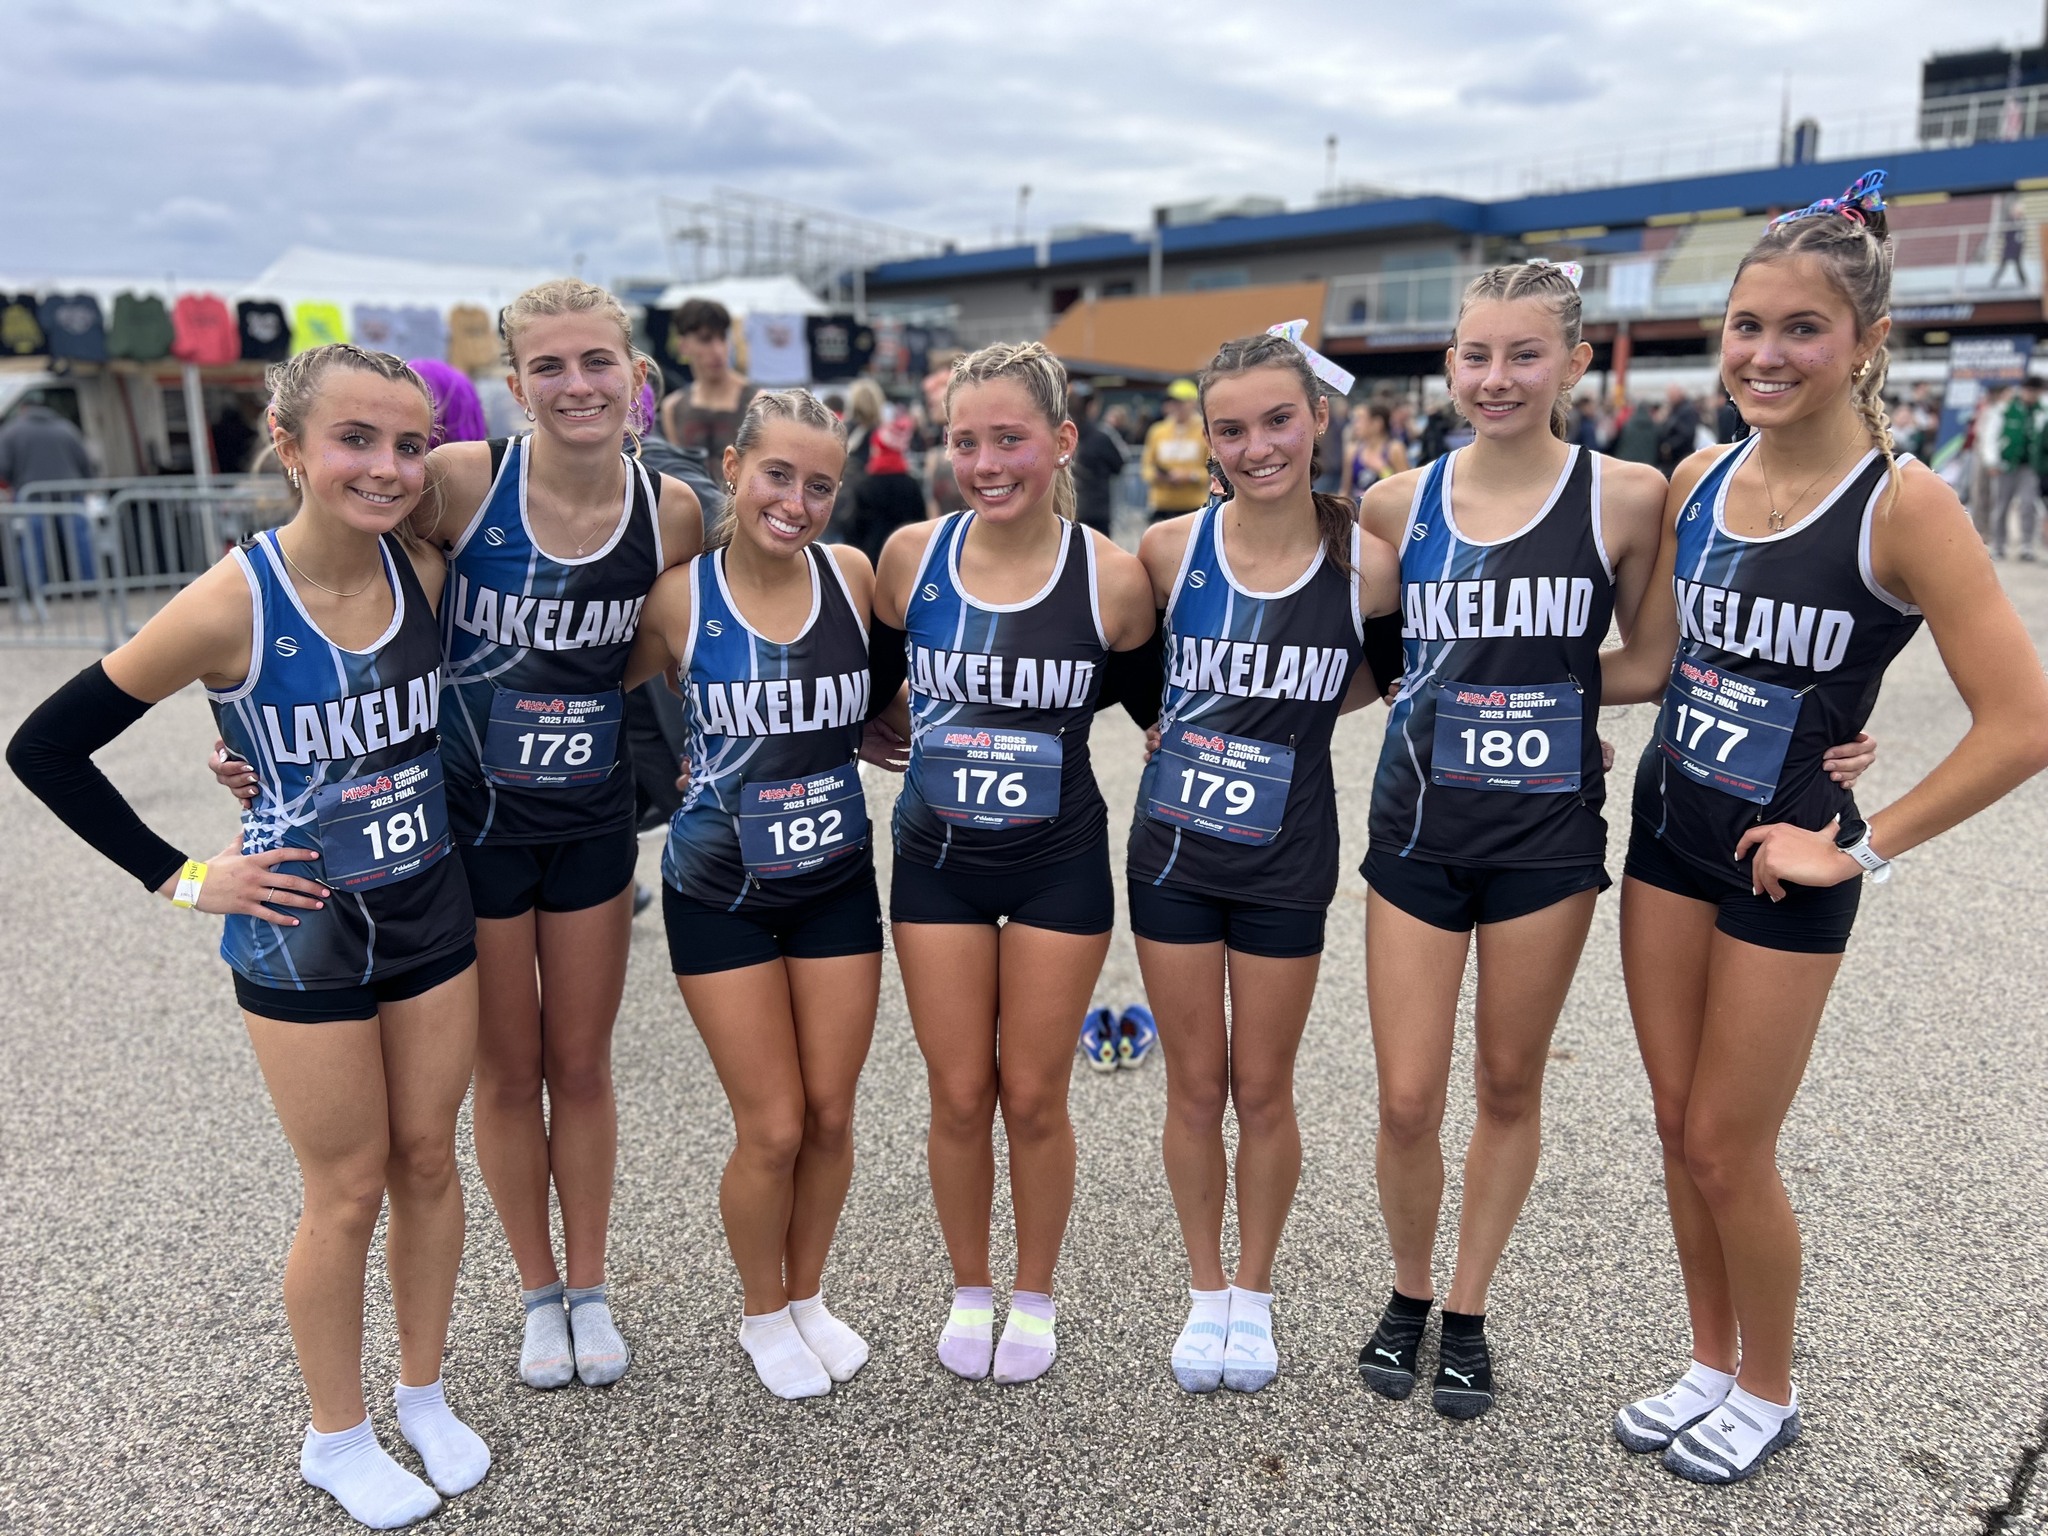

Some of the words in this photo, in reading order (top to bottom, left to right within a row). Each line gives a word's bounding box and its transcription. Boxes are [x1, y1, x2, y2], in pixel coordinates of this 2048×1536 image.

[455, 574, 647, 651] LAKELAND
[1673, 576, 1855, 672] KELAND
[1169, 634, 1349, 702] LAKELAND
[1510, 692, 1545, 700] CROSS
[1722, 678, 1756, 696] CROSS
[568, 700, 598, 708] CROSS
[692, 668, 871, 736] LAKELAND
[1510, 699, 1558, 708] COUNTRY
[1690, 686, 1713, 702] 2025
[1714, 694, 1738, 712] FINAL
[1720, 686, 1768, 708] COUNTRY
[262, 666, 441, 765] LAKELAN
[567, 704, 606, 715] COUNTRY
[1480, 710, 1504, 718] 2025
[1506, 710, 1534, 718] FINAL
[538, 716, 561, 724] 2025
[562, 716, 586, 724] FINAL
[994, 735, 1026, 744] CROSS
[1676, 704, 1749, 762] 177
[518, 732, 594, 766] 178
[967, 750, 988, 760] 2025
[990, 752, 1016, 761] FINAL
[994, 743, 1038, 752] COUNTRY
[1228, 742, 1261, 754] CROSS
[1460, 728, 1550, 768] 180
[1199, 752, 1220, 764] 2025
[1222, 758, 1247, 770] FINAL
[1226, 750, 1271, 764] COUNTRY
[393, 765, 420, 782] CROSS
[395, 768, 429, 790] COUNTRY
[808, 776, 834, 789] CROSS
[808, 780, 844, 796] COUNTRY
[953, 768, 1028, 807] 176
[1181, 768, 1256, 816] 179
[370, 794, 393, 809] 2025
[394, 786, 416, 801] FINAL
[783, 800, 805, 810] 2025
[806, 794, 828, 806] FINAL
[362, 804, 429, 860] 181
[768, 810, 844, 856] 182
